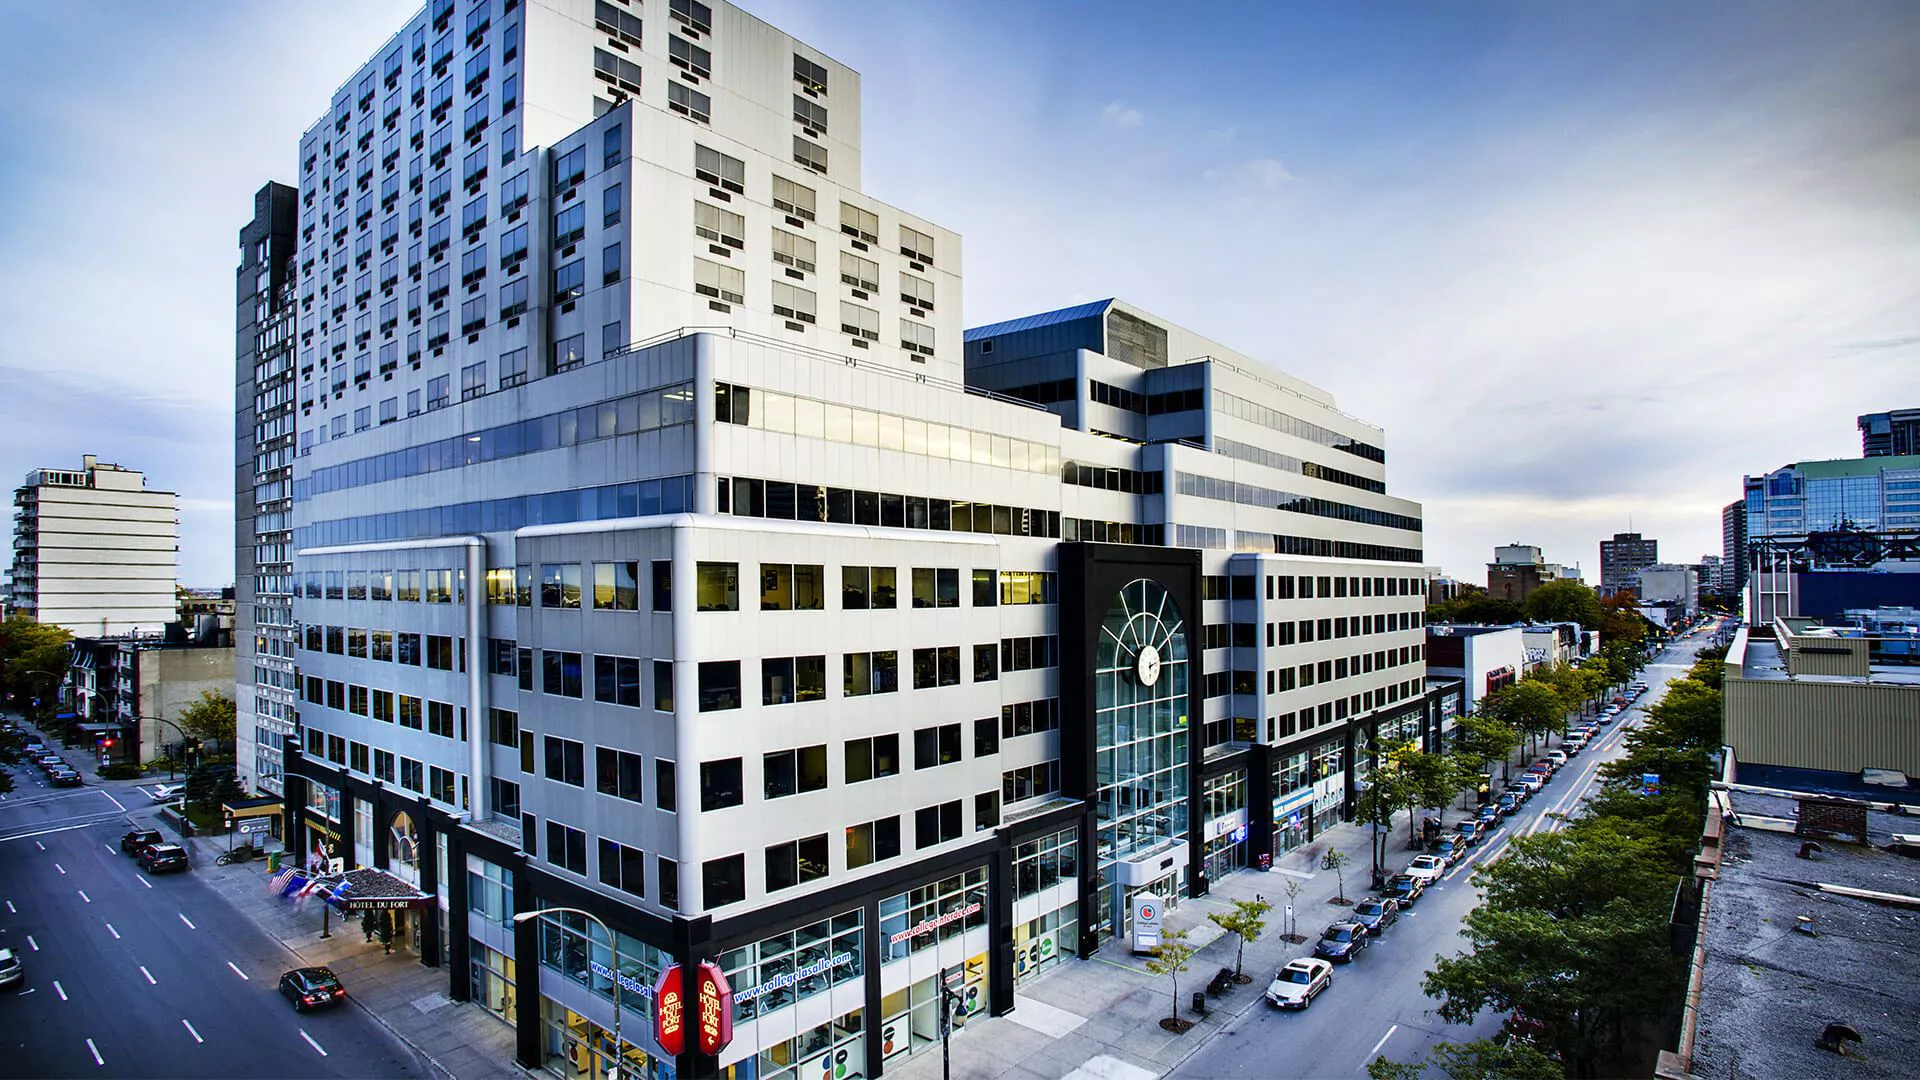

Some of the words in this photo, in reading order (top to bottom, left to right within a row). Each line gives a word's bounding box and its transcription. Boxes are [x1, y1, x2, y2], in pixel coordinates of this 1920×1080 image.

[377, 901, 389, 909] DU
[390, 901, 409, 909] FORT
[733, 951, 851, 1004] www.collegelasalle.com
[665, 1006, 678, 1021] DU
[705, 1003, 717, 1017] DU
[663, 1014, 680, 1028] FORT
[702, 1012, 719, 1027] FORT
